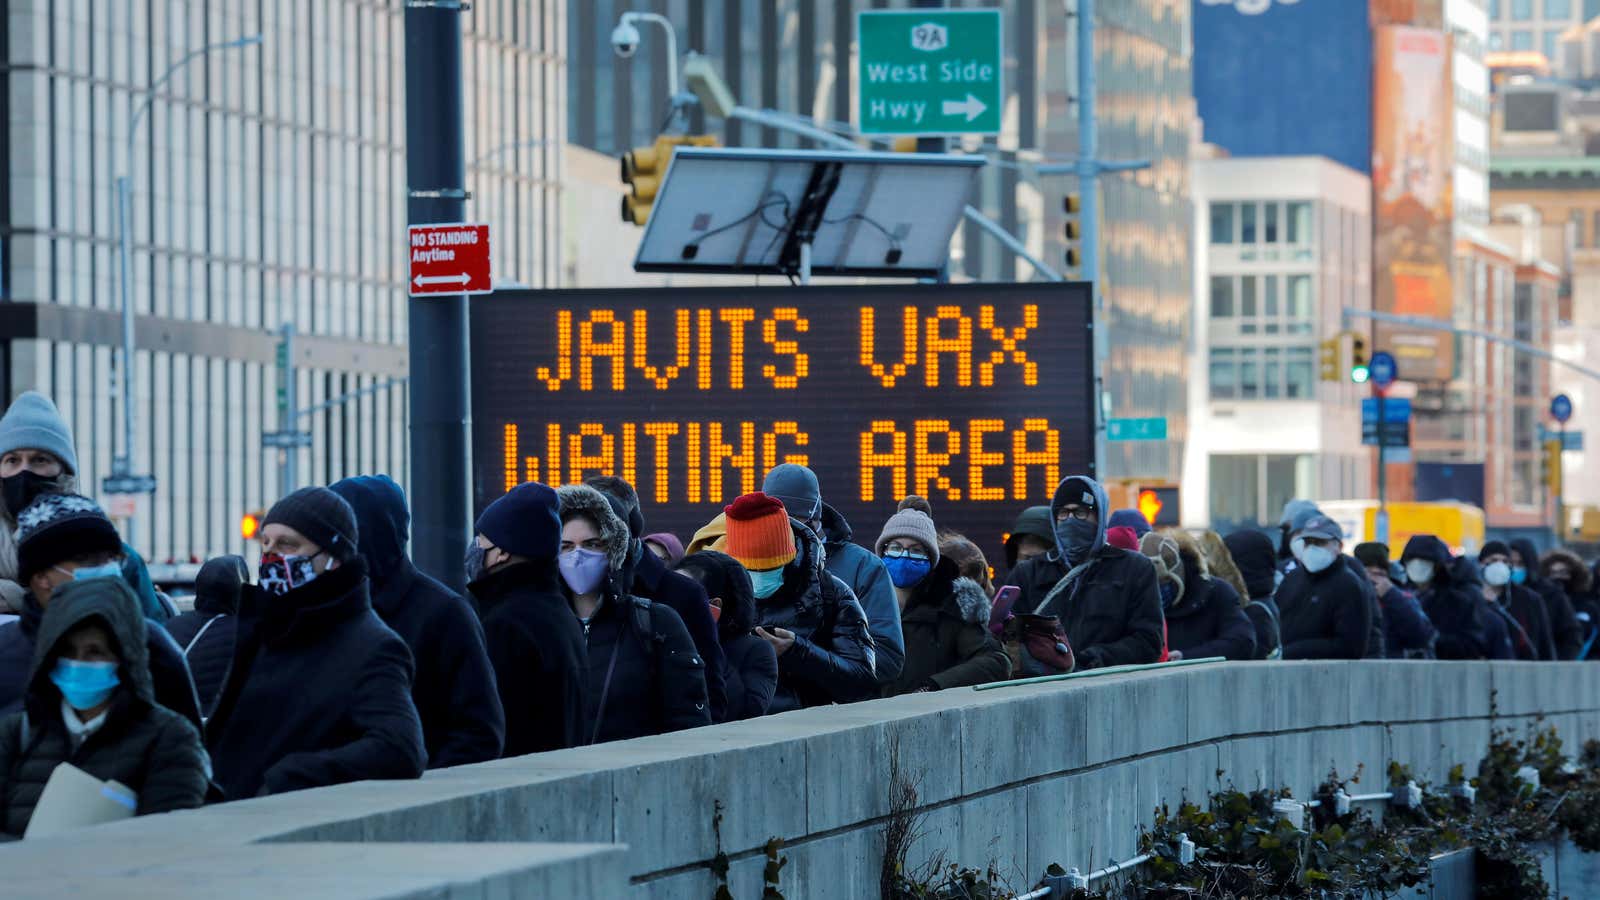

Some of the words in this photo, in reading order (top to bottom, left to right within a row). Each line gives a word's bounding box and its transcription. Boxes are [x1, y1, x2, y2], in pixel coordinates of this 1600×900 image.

[914, 28, 942, 46] 9A
[867, 62, 927, 82] West
[940, 59, 993, 82] Side
[870, 98, 926, 124] Hwy
[411, 232, 426, 247] NO
[427, 230, 479, 246] STANDING
[412, 247, 455, 264] Anytime
[536, 307, 809, 391] JAVITS
[859, 303, 1039, 388] VAX
[504, 421, 809, 503] WAITING
[859, 418, 1061, 501] AREA
